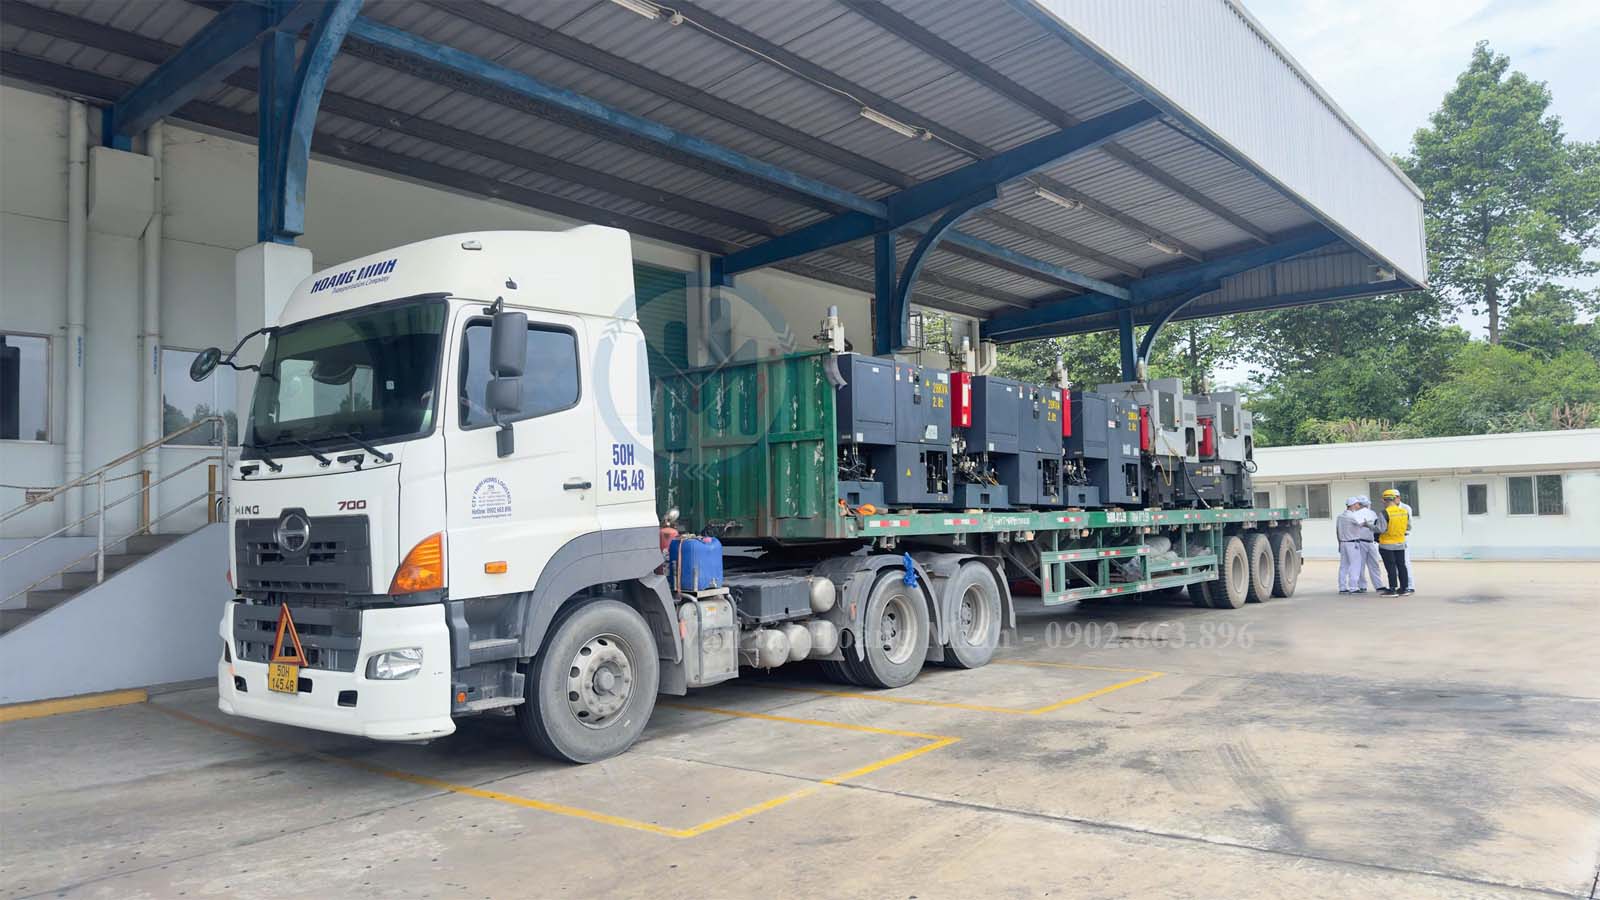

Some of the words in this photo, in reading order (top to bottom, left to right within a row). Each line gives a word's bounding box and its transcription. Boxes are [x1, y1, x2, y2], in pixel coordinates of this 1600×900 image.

[311, 269, 357, 294] HOANG
[357, 259, 397, 280] MINH
[612, 444, 634, 466] 50H
[606, 469, 645, 492] 145.48
[235, 505, 260, 515] HINO
[337, 500, 367, 511] 700
[276, 664, 290, 677] 50H
